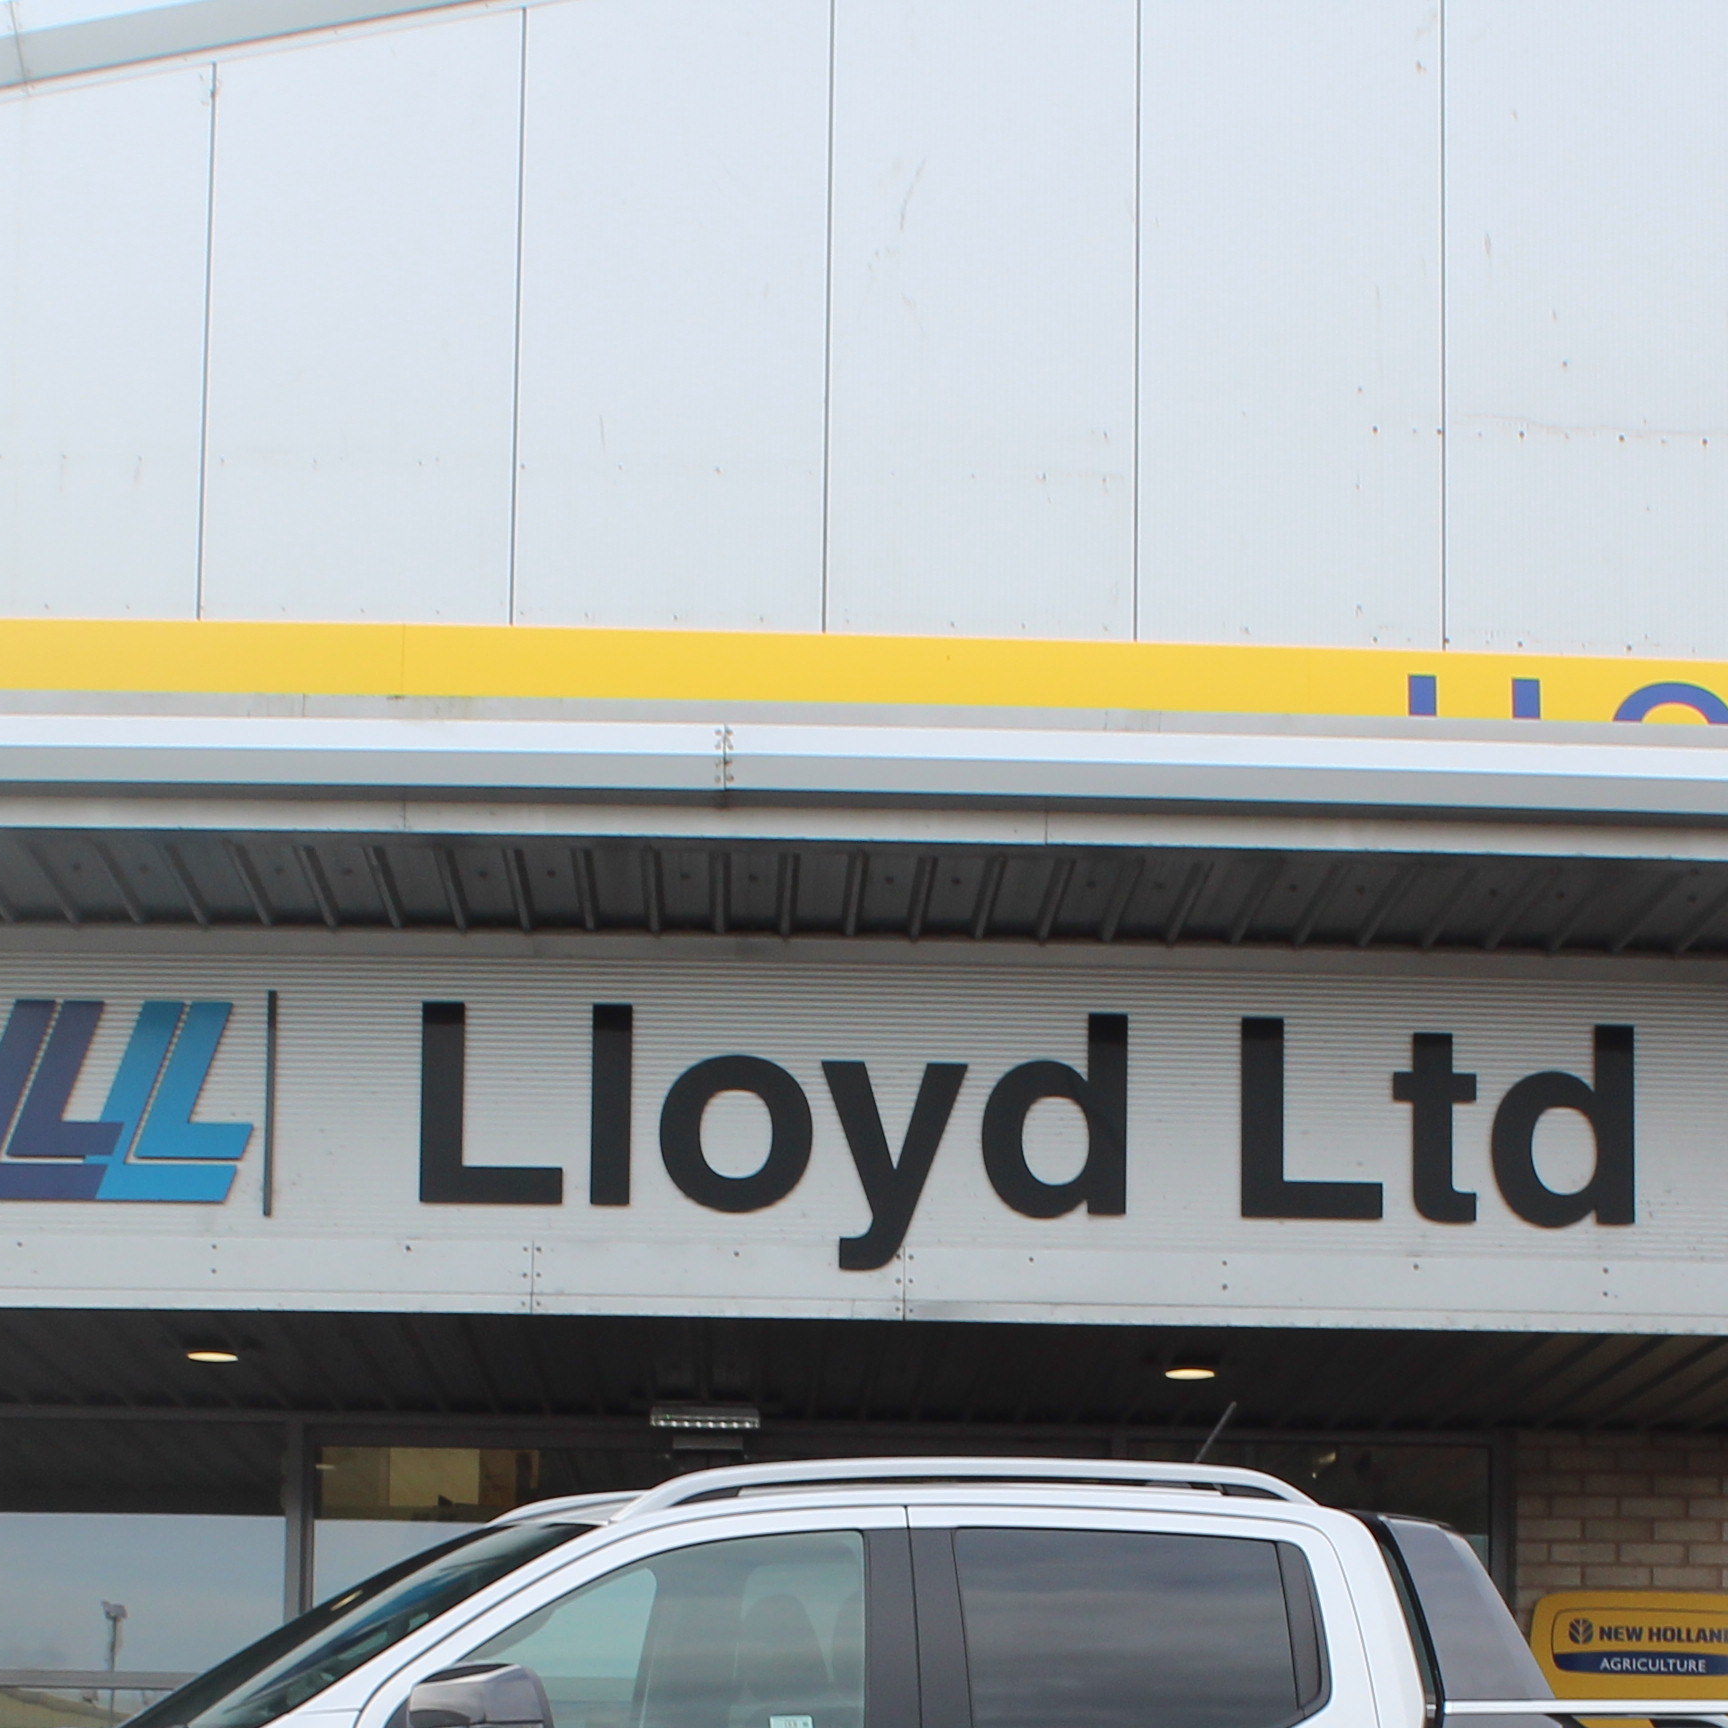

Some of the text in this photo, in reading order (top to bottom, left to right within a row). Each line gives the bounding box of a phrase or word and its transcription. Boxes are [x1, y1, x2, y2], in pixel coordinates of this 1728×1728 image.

[419, 1001, 1129, 1271] Lloyd
[1240, 1015, 1635, 1228] Ltd
[1599, 1626, 1643, 1642] NEW
[1599, 1657, 1706, 1673] AGRICULTURE
